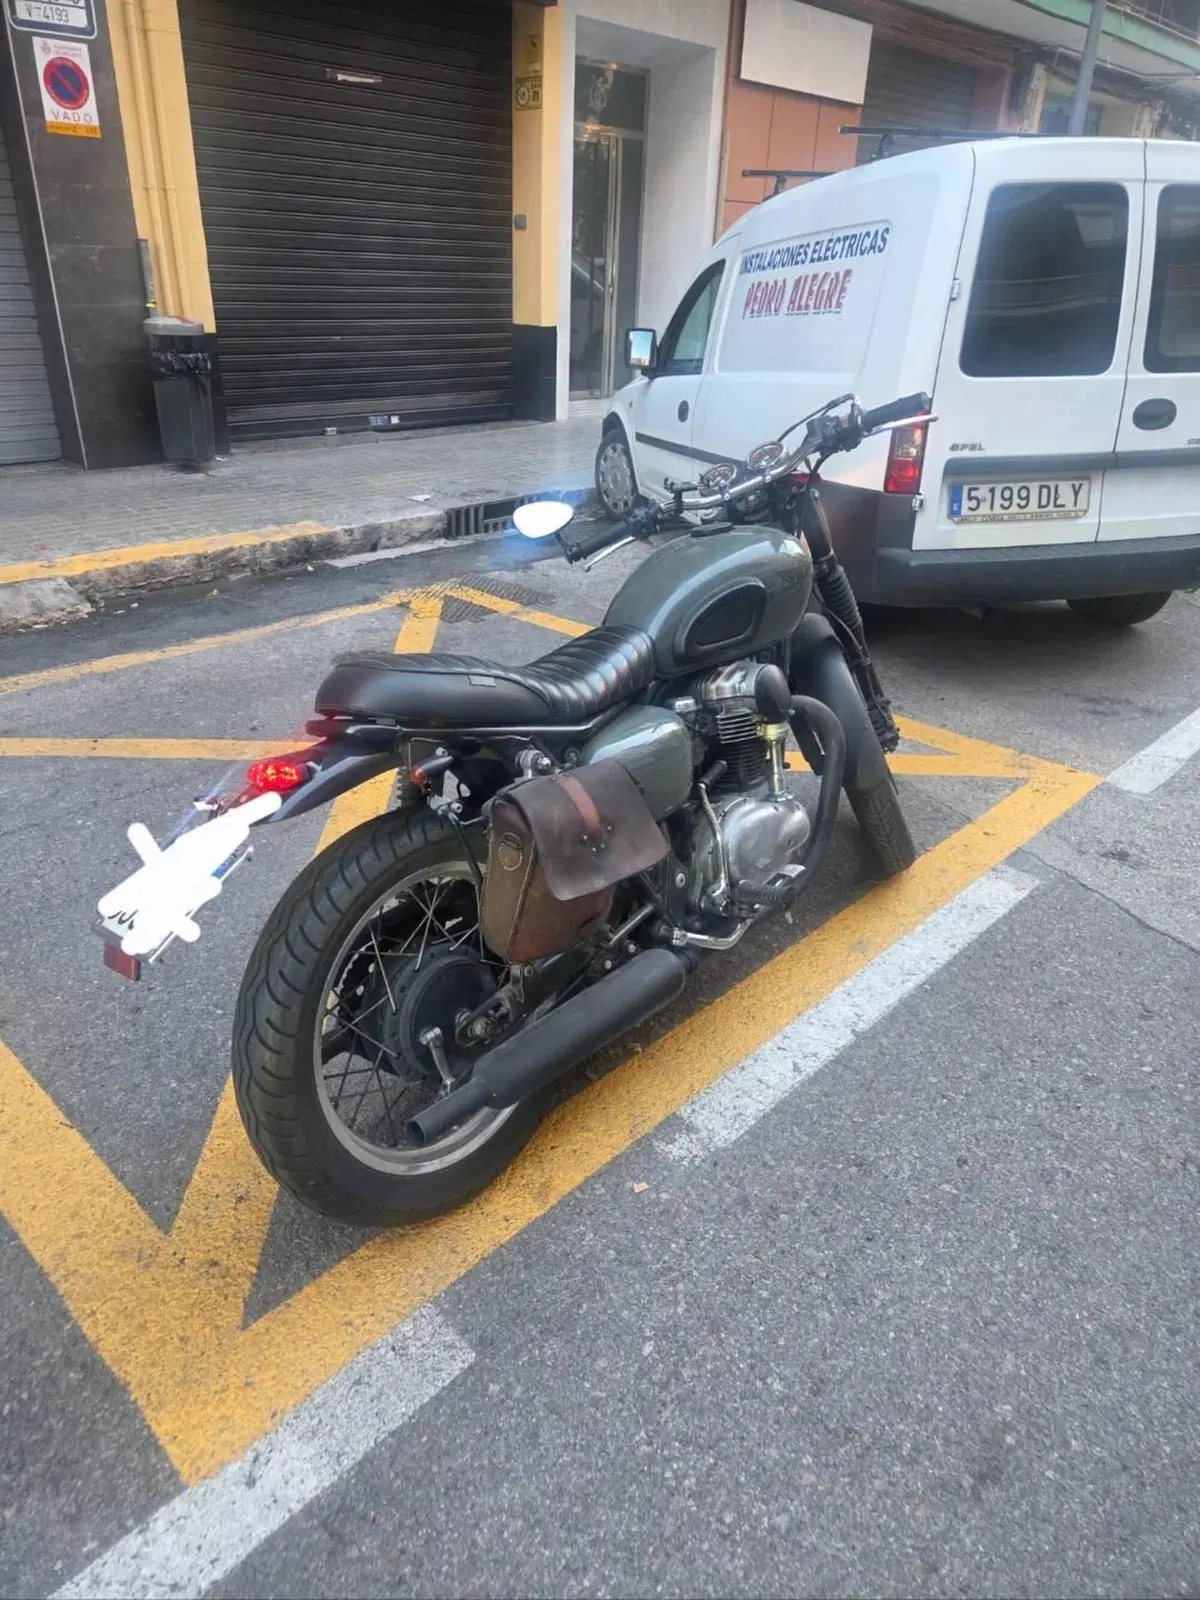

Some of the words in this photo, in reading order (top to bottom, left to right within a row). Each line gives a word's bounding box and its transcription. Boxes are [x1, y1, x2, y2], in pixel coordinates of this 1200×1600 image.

[52, 110, 93, 124] VADO
[739, 242, 810, 276] INSTALACIONES
[809, 226, 890, 264] ELÉCTRICAS
[742, 277, 787, 320] PEDRO
[787, 268, 853, 316] ALEGRE
[949, 443, 985, 452] OPEL
[967, 485, 1031, 512] 5199
[1037, 482, 1084, 510] DLY
